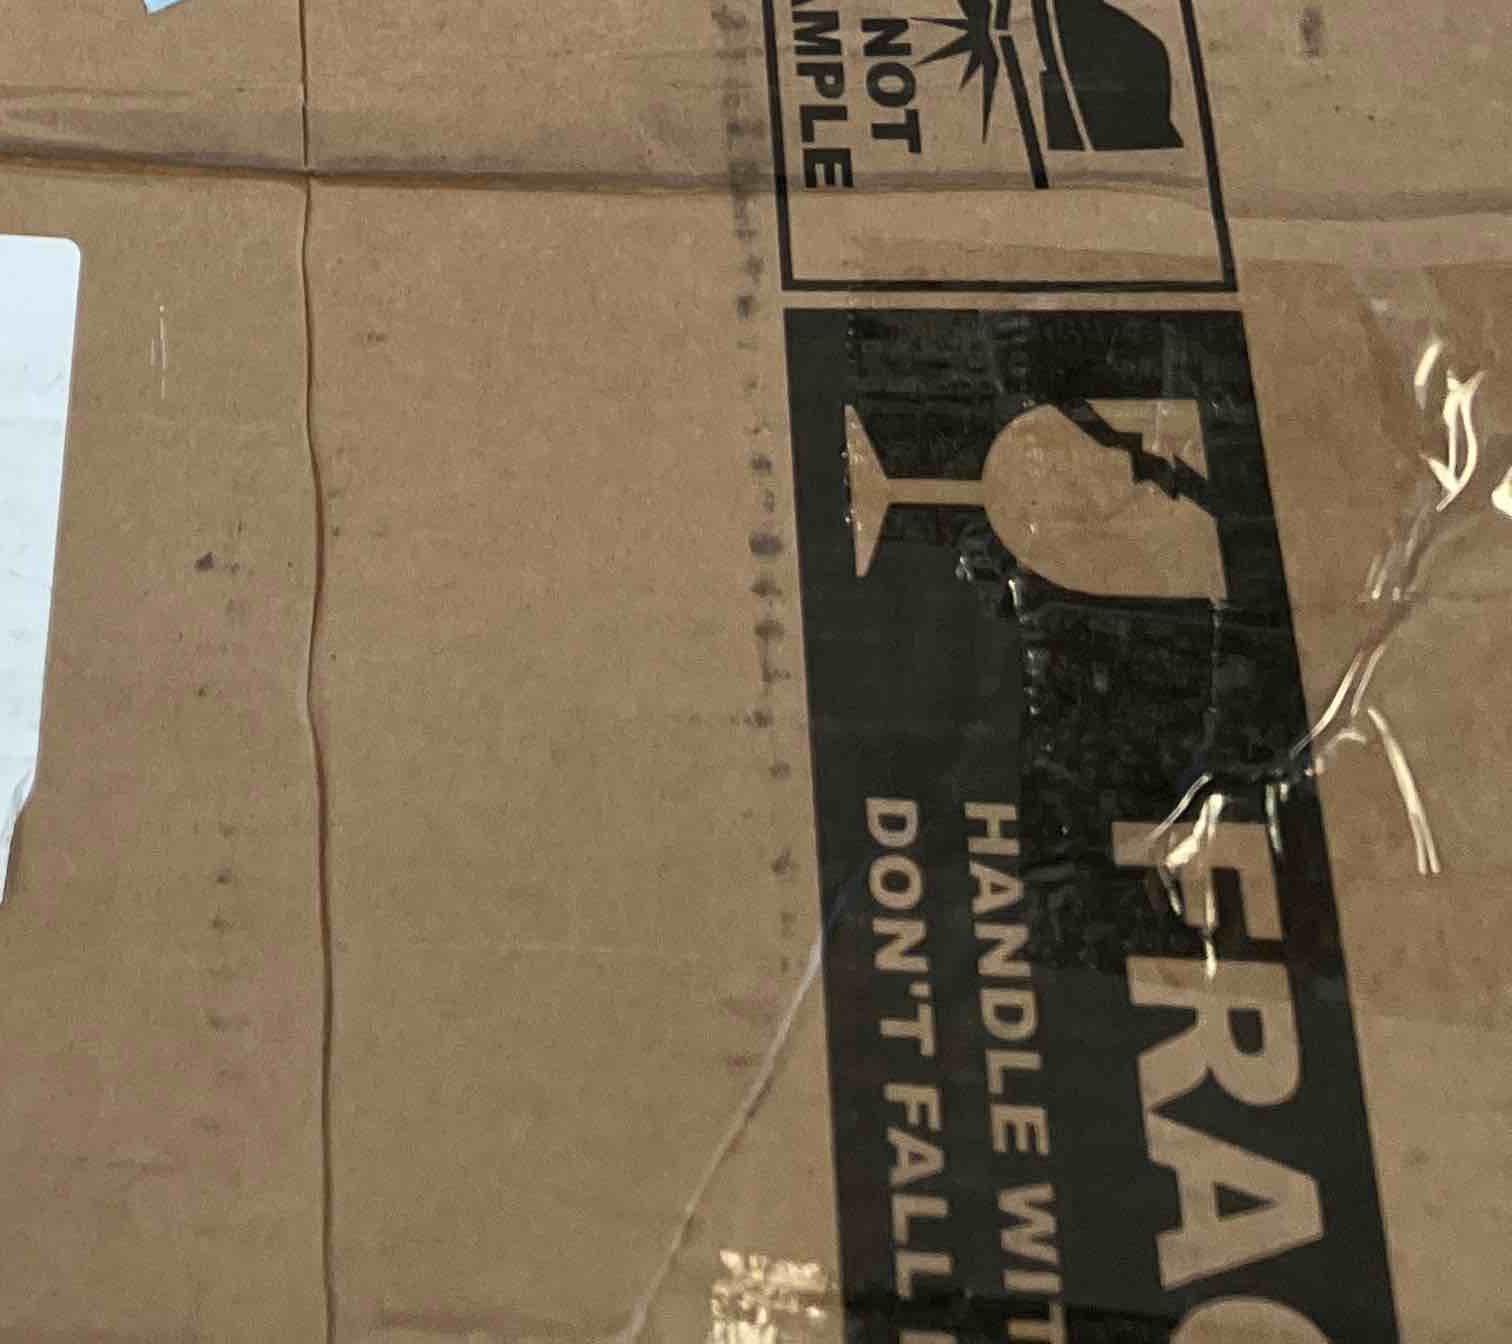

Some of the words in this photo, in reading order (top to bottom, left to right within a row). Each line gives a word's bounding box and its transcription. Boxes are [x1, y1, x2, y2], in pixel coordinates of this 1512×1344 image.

[861, 18, 922, 154] NOT
[865, 796, 936, 1057] DON'T
[964, 800, 1050, 1156] HANDLE
[884, 1081, 954, 1299] FALL
